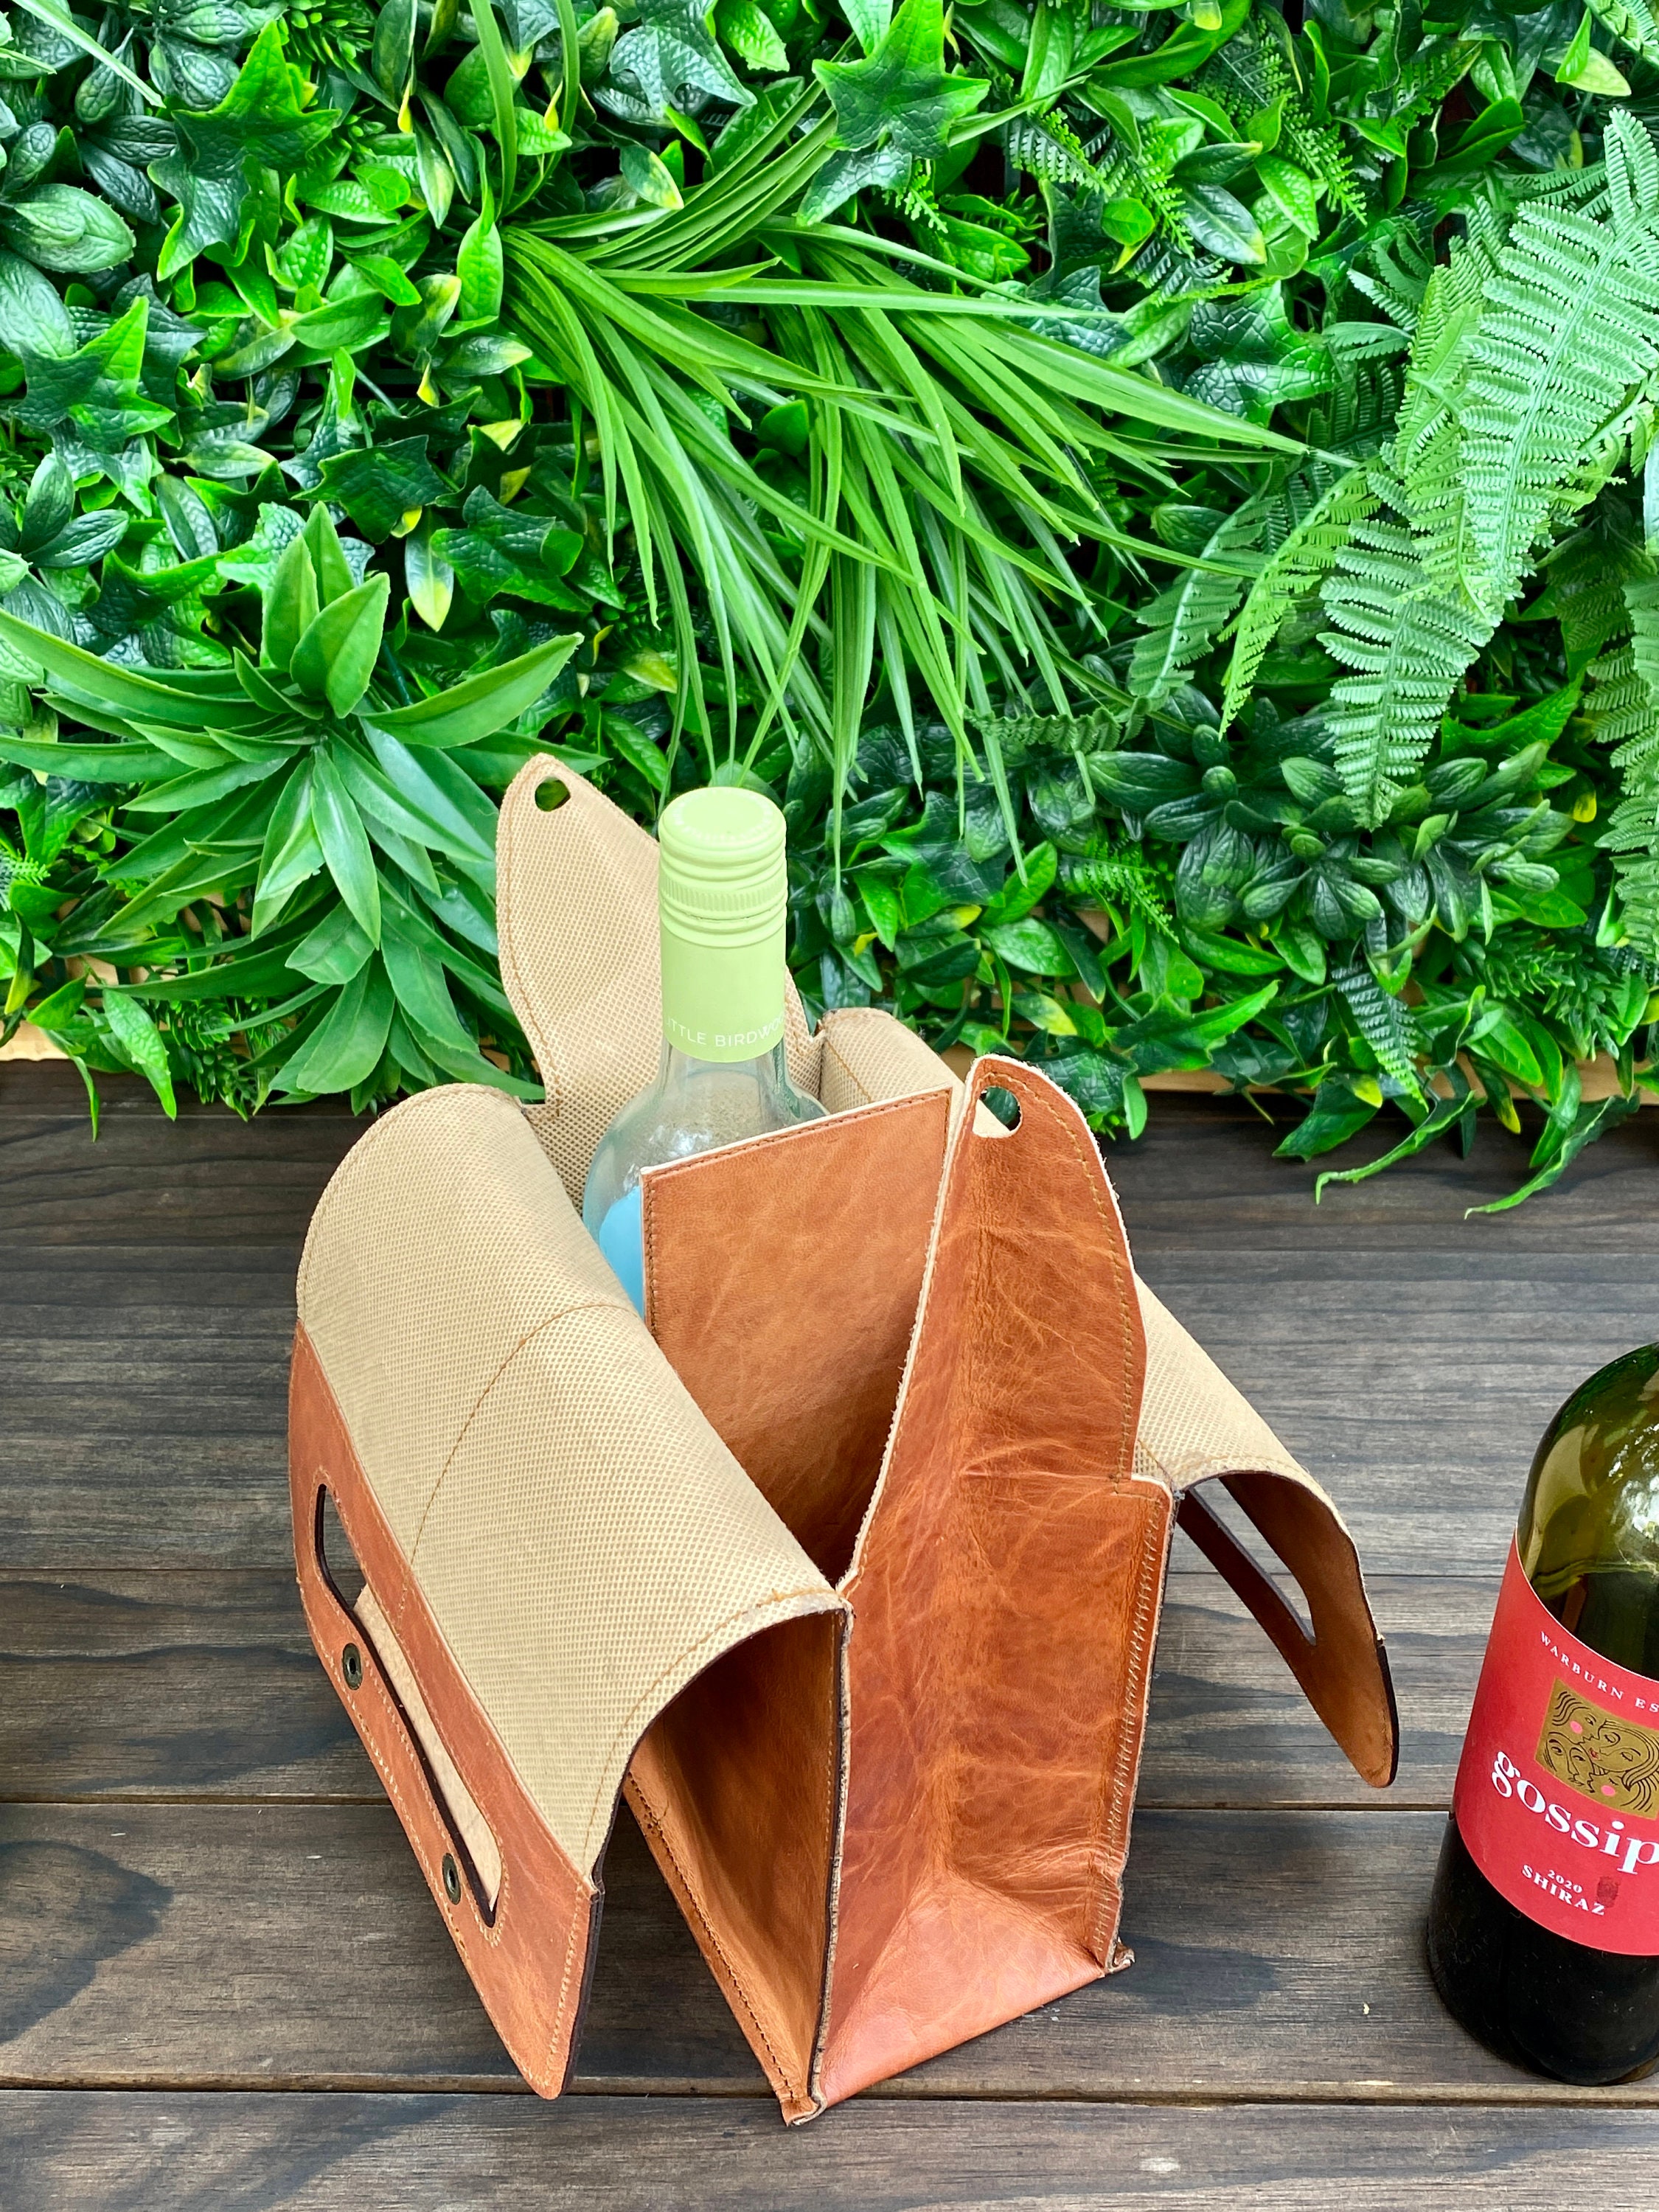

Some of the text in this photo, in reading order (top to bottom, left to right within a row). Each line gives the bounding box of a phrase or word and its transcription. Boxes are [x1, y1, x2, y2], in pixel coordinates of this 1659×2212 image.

[1540, 1630, 1659, 1713] WARBURN ES
[1491, 1750, 1659, 1875] gossip
[1521, 1864, 1605, 1916] SHIRAZ
[1547, 1869, 1583, 1894] 2020
